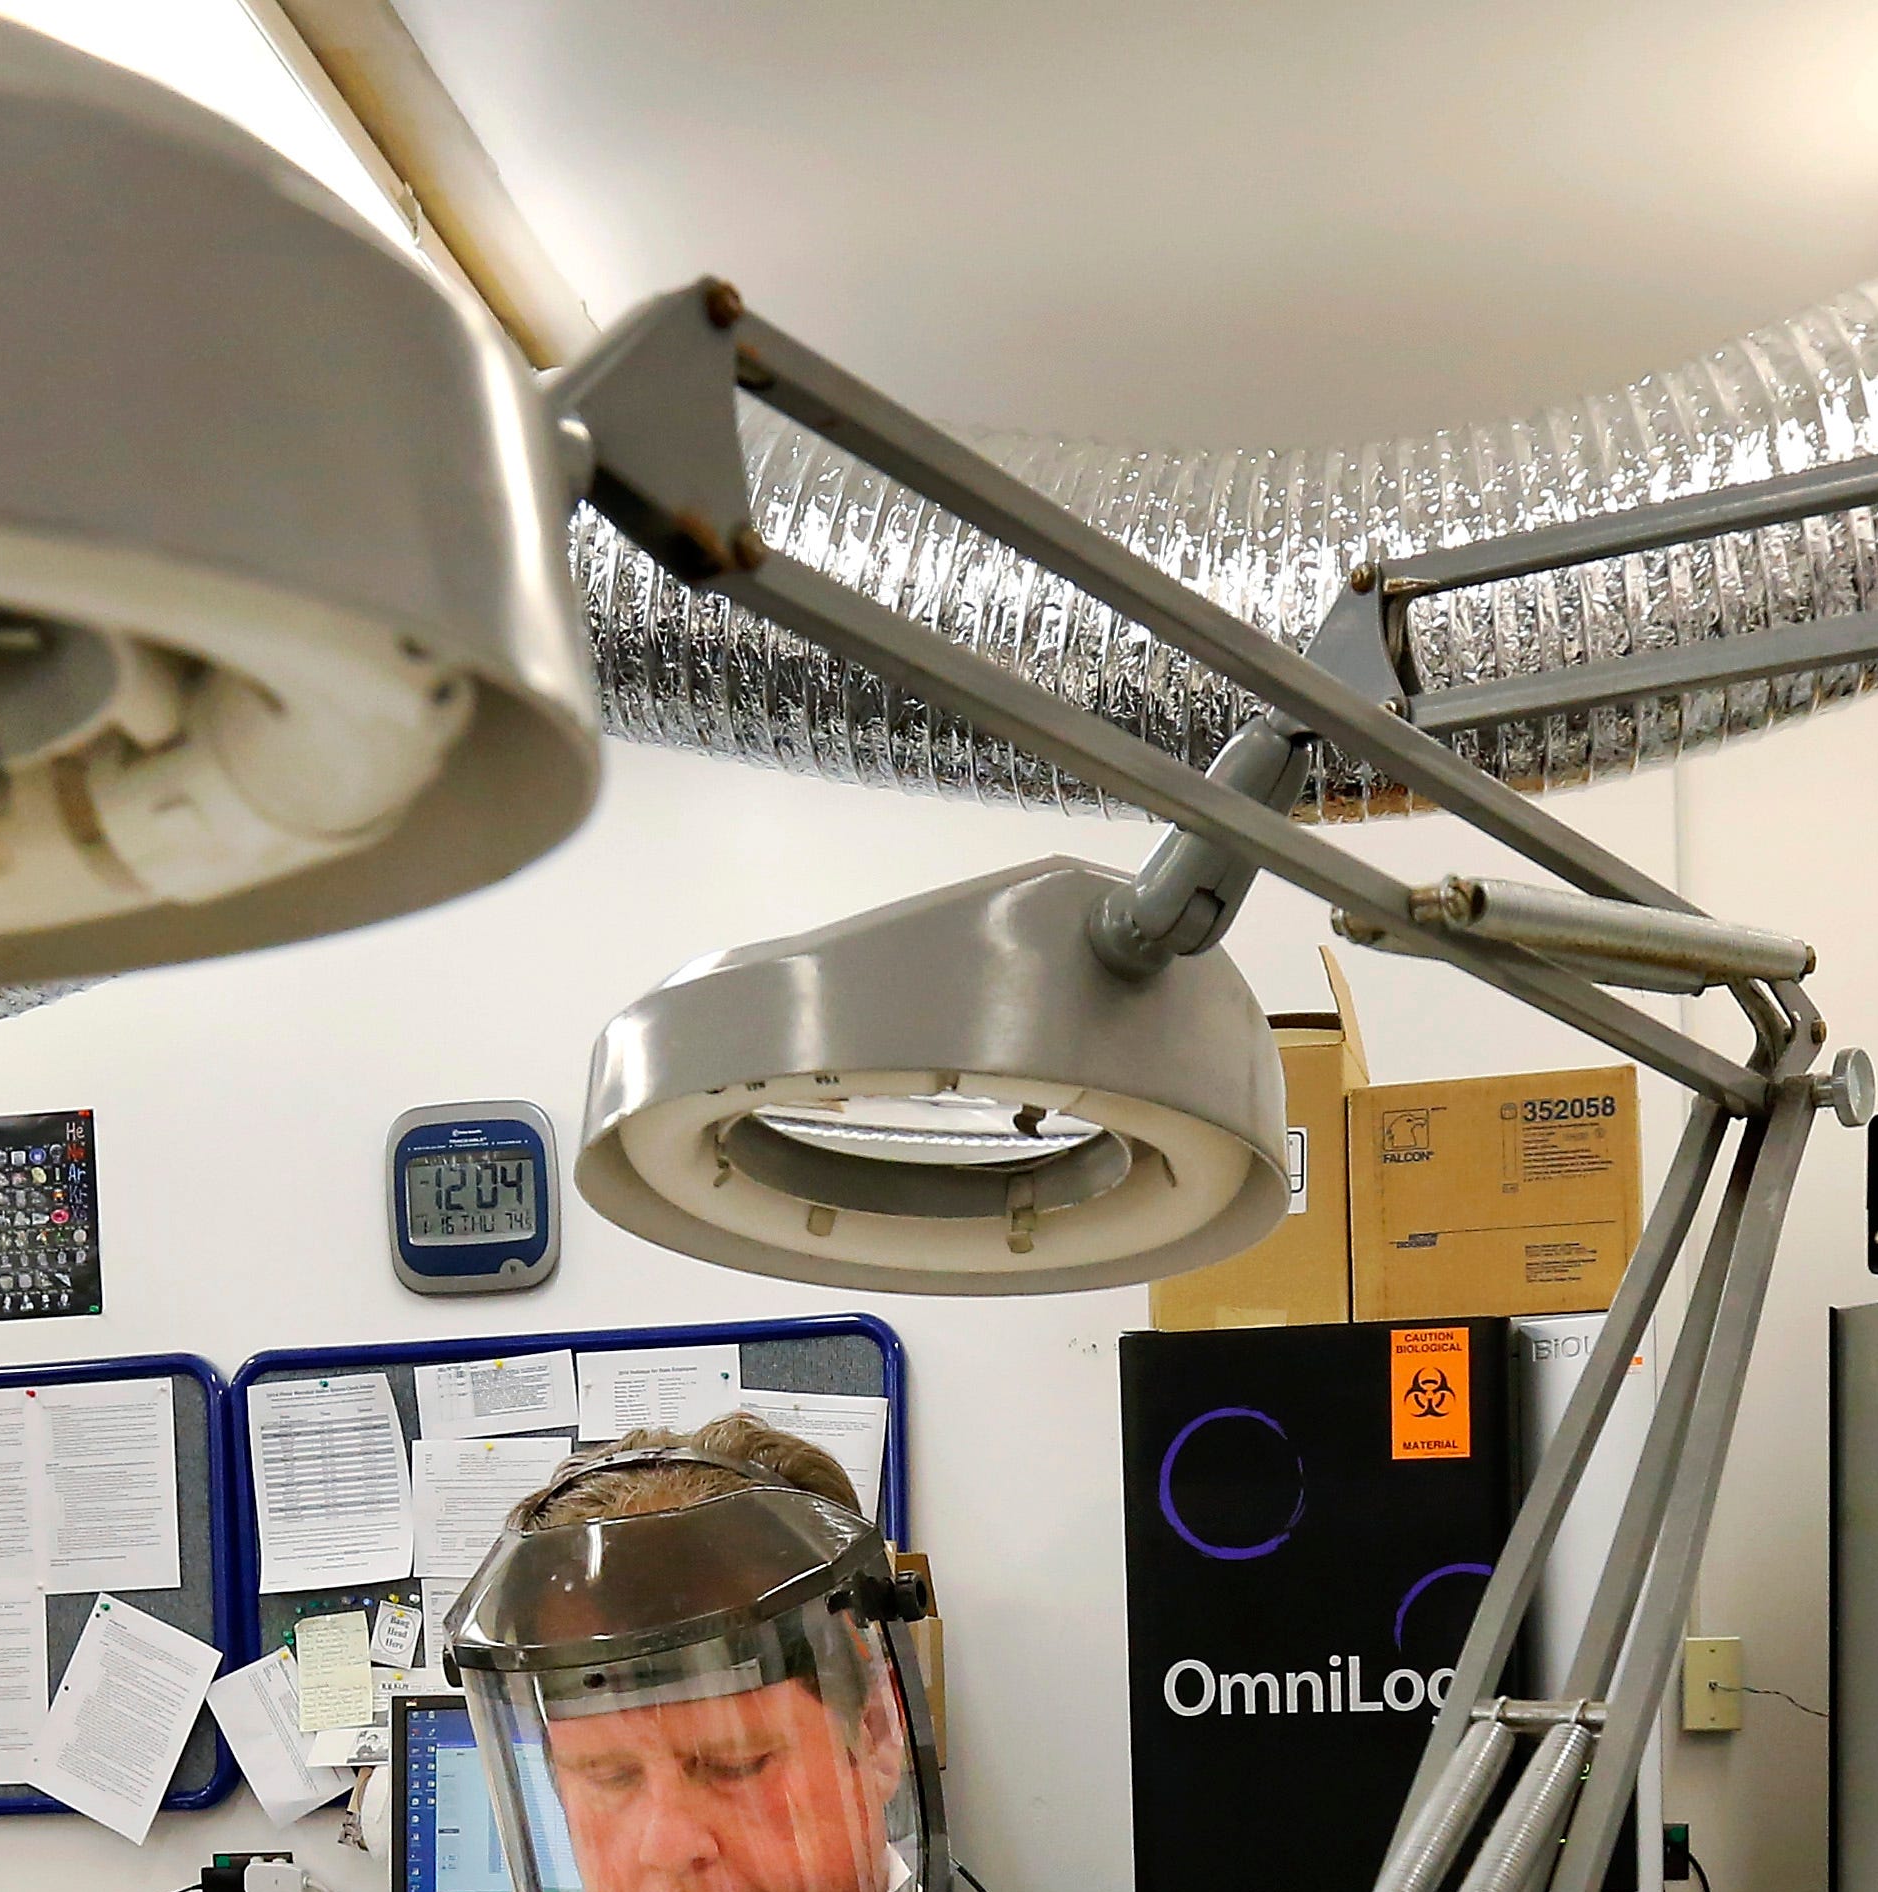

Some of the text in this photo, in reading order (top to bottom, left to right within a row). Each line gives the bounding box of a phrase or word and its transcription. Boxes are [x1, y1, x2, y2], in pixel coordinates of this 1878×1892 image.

[1523, 1096, 1616, 1122] 352058
[66, 1122, 85, 1140] He
[68, 1163, 86, 1182] Ar
[462, 1214, 495, 1232] THU
[1404, 1332, 1454, 1343] CAUTION
[1396, 1342, 1462, 1354] BIOLOGICAL
[1403, 1440, 1459, 1451] MATERIAL
[385, 1638, 404, 1650] Here
